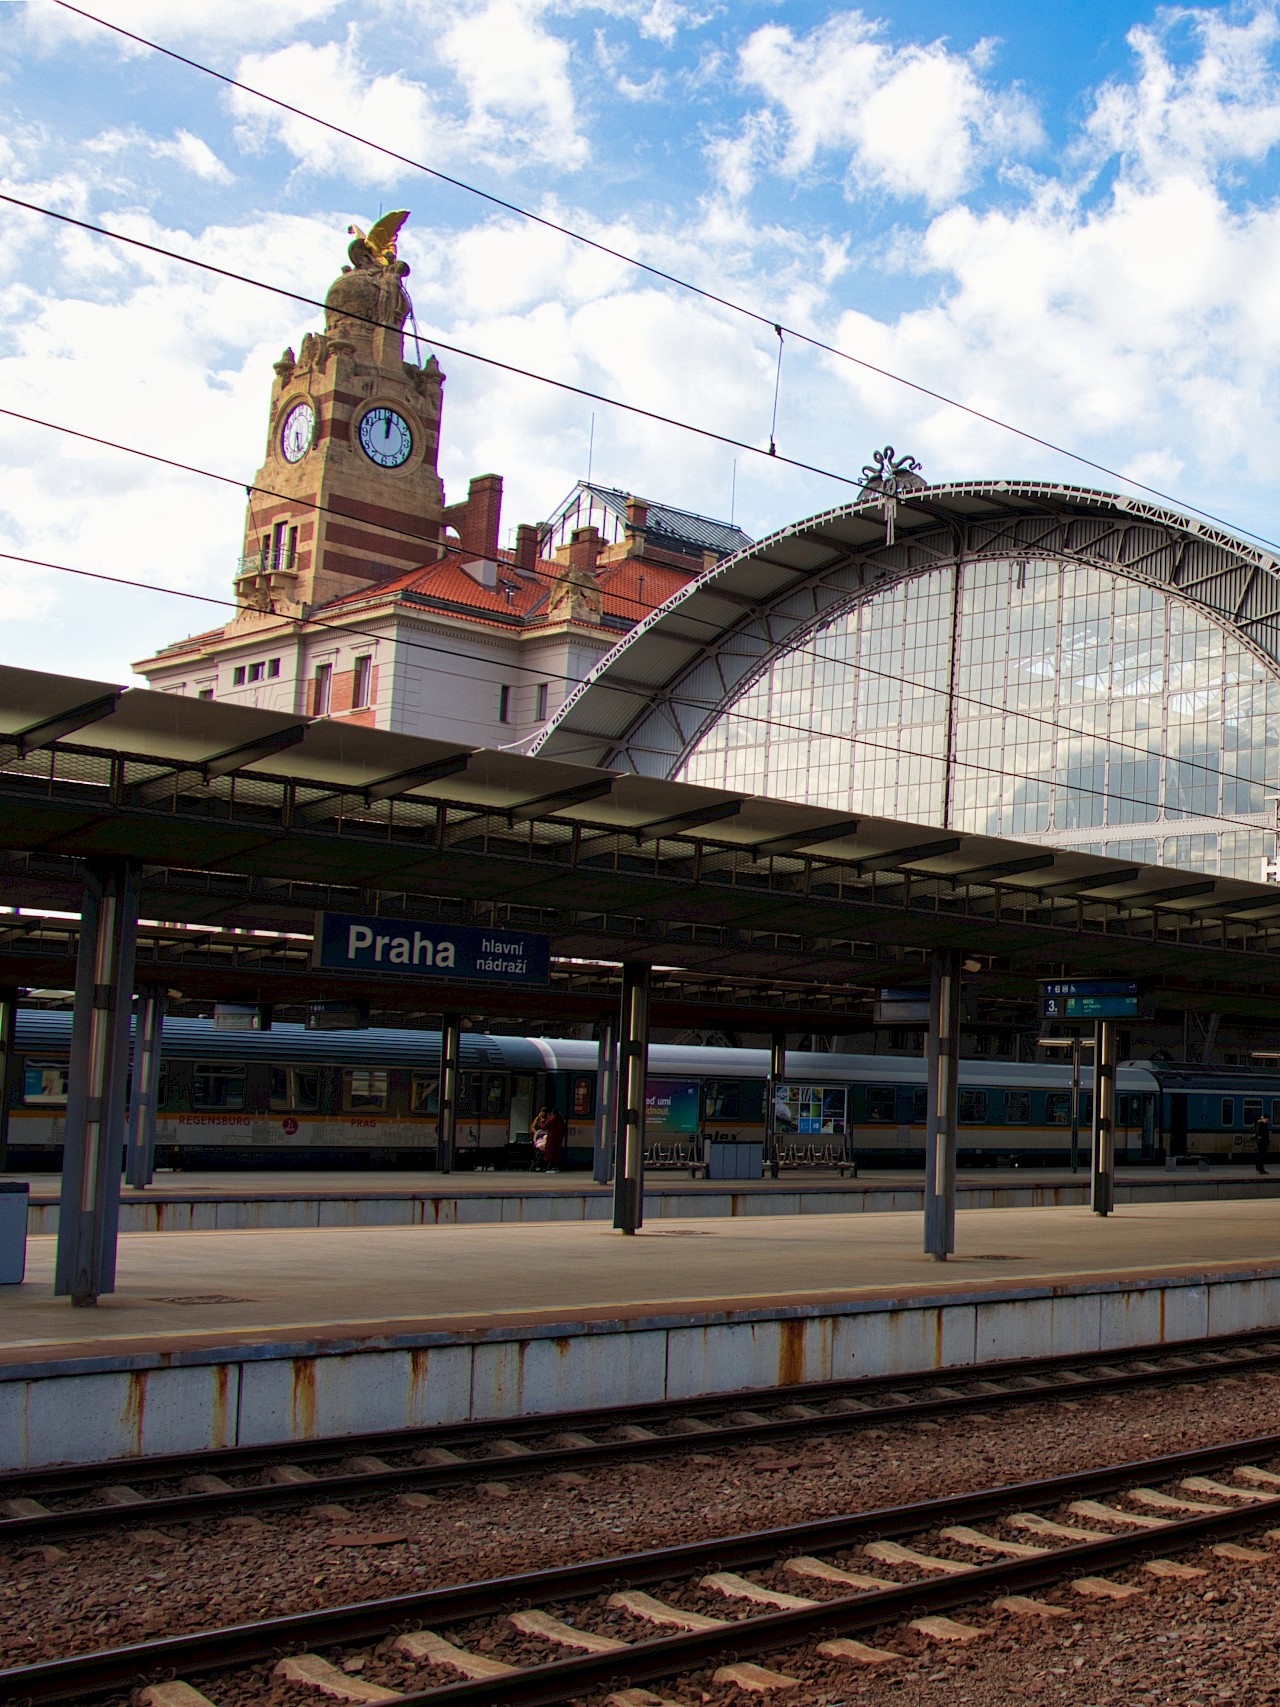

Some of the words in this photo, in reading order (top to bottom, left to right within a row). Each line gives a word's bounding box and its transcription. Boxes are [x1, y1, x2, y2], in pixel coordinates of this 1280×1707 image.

[347, 924, 456, 968] Praha
[481, 938, 524, 956] hlavní
[476, 958, 527, 974] nádraží
[179, 1115, 251, 1126] REGENSBURG
[351, 1119, 376, 1128] PRAG
